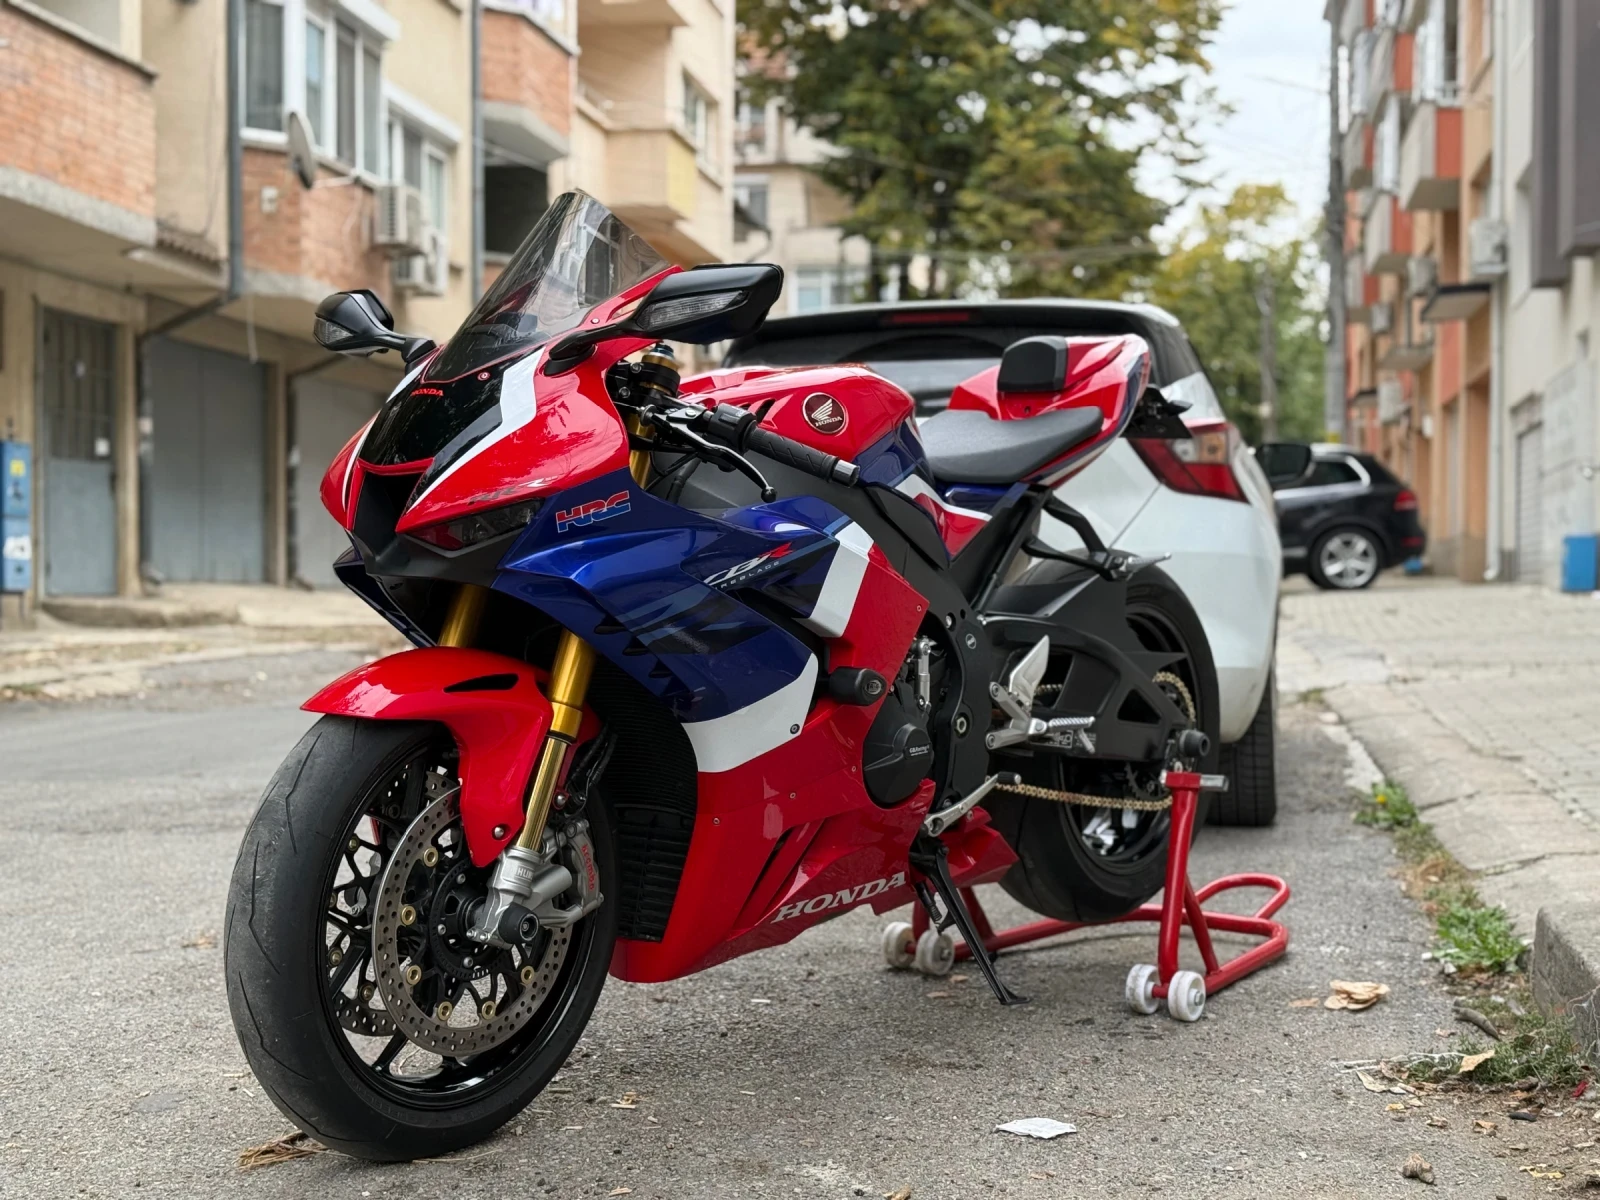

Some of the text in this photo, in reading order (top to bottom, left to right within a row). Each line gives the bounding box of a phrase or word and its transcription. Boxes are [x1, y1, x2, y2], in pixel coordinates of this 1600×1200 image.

[815, 416, 842, 427] HONDA
[555, 490, 631, 533] HRC
[770, 871, 906, 924] HONDA
